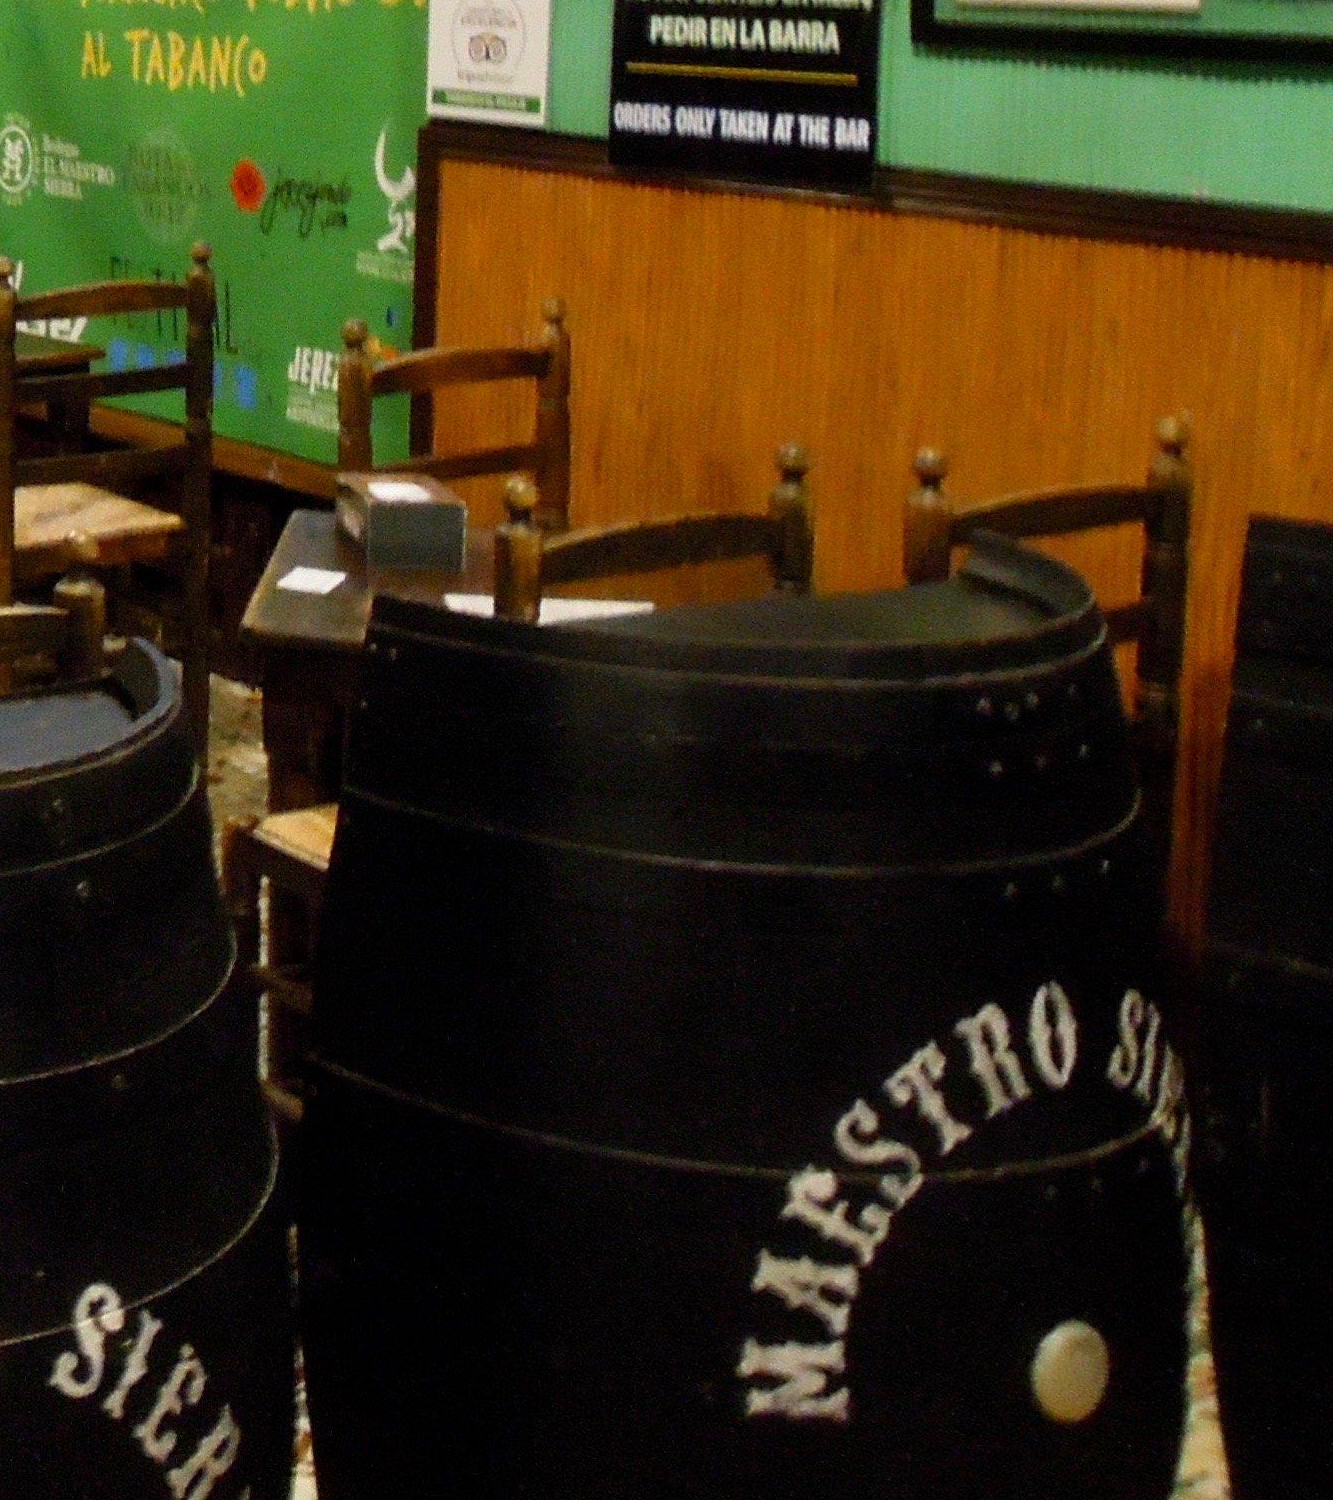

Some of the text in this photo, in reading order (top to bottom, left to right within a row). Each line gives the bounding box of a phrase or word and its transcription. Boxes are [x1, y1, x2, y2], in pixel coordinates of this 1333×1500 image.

[81, 28, 270, 98] AL TABANCO
[649, 14, 840, 56] PEDIR EN LA BARRA
[614, 102, 870, 151] ORDERS ONLY TAKEN AT THE BAR
[736, 980, 1078, 1421] MAESTRO
